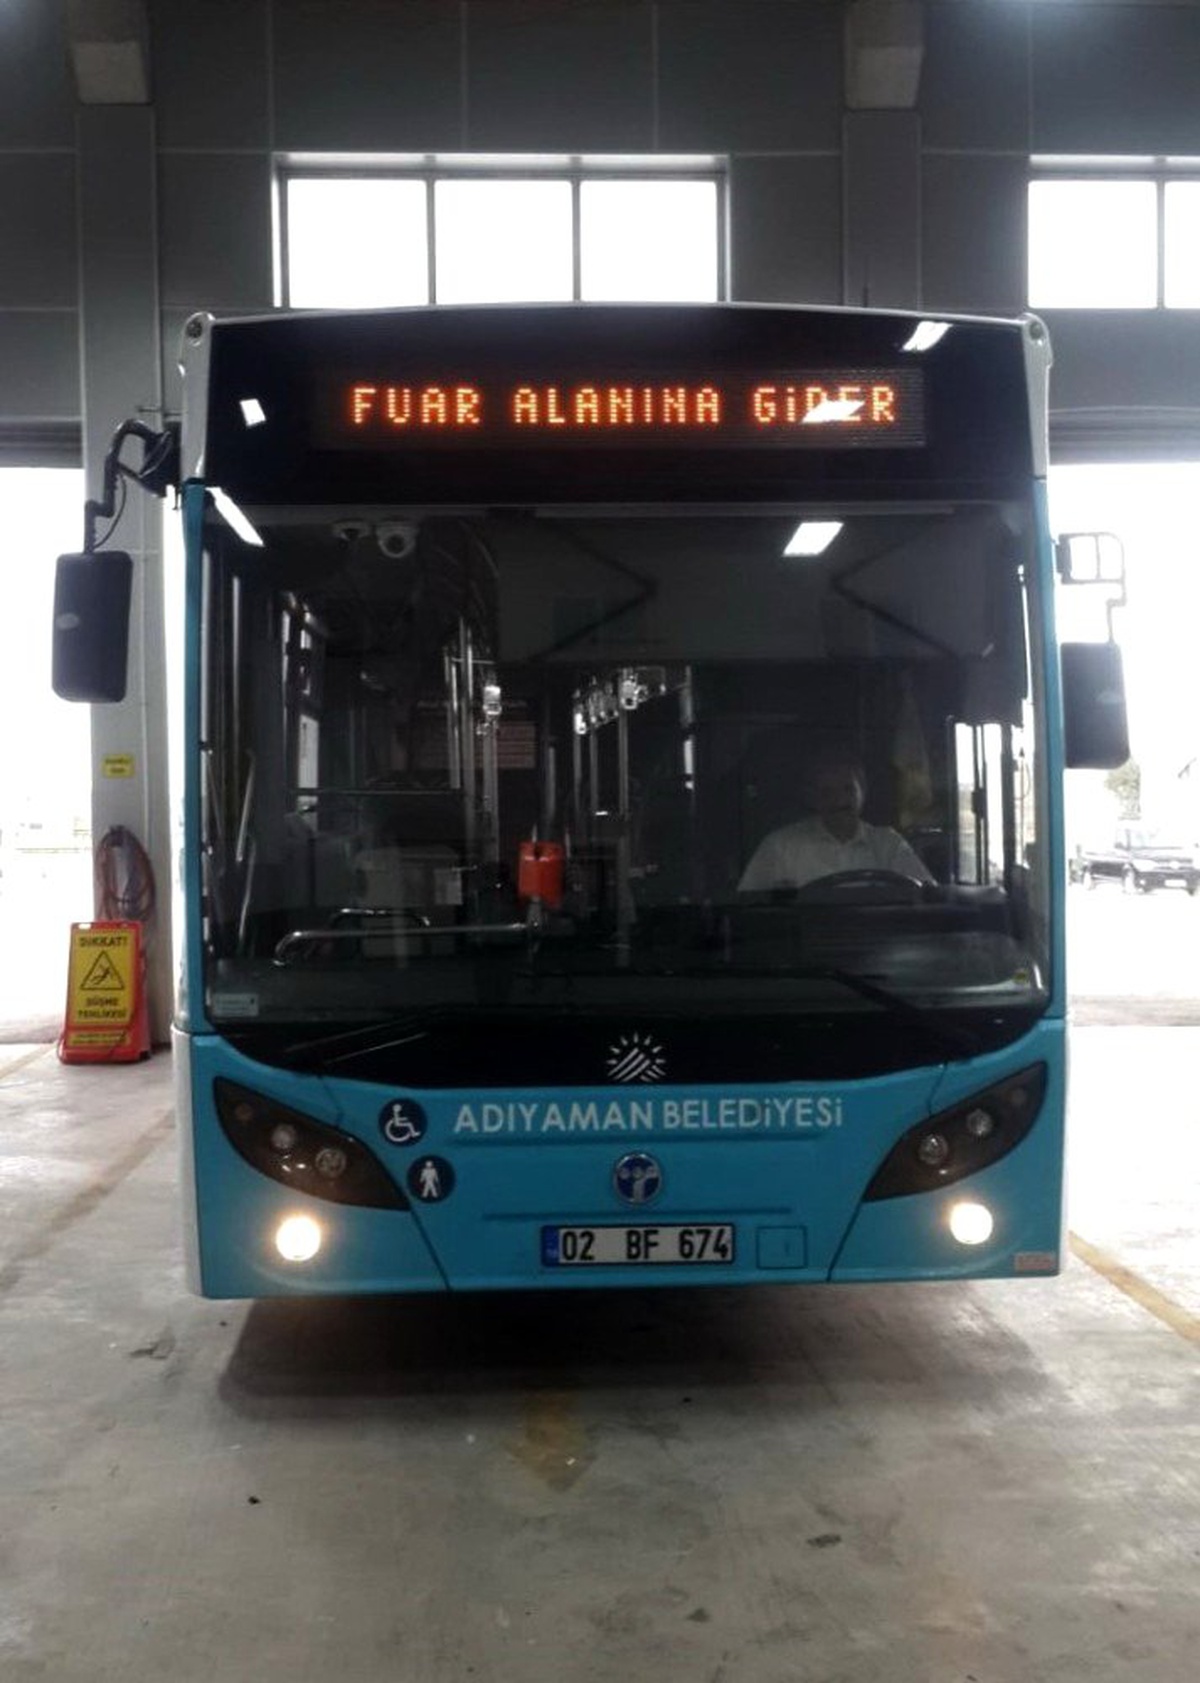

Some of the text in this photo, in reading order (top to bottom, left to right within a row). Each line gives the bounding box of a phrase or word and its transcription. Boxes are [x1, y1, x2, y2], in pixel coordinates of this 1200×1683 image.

[353, 387, 480, 424] FUAR
[514, 387, 719, 424] ALANINA
[454, 1101, 654, 1133] ADIYAMAN
[561, 1231, 595, 1261] 02
[626, 1229, 660, 1259] BF
[678, 1229, 729, 1260] 674
